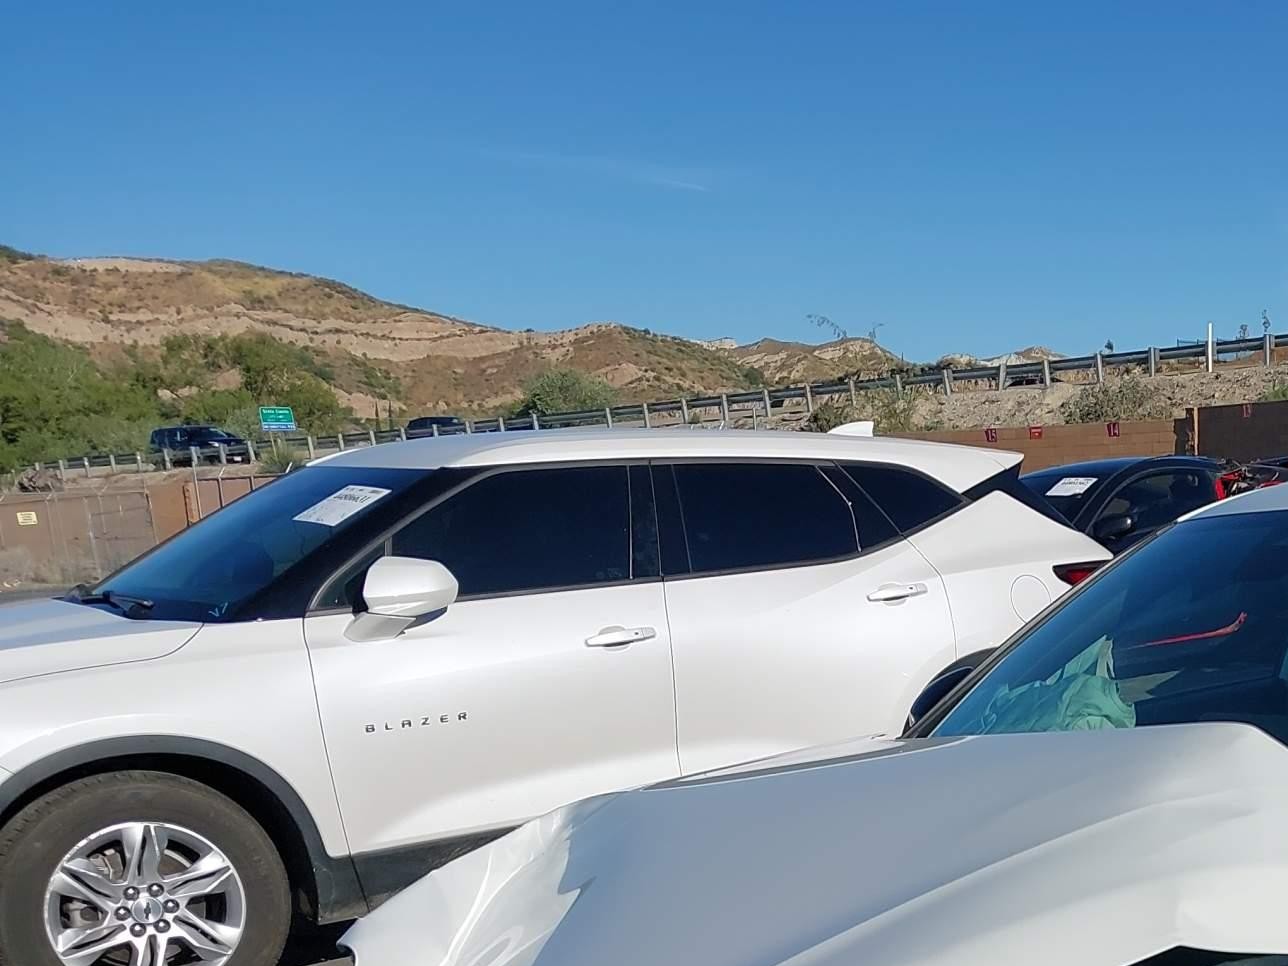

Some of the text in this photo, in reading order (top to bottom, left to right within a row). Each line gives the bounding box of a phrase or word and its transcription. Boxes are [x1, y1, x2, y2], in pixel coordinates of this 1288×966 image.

[986, 429, 997, 441] 15
[1109, 423, 1120, 437] 14
[365, 712, 468, 733] BLAZER
